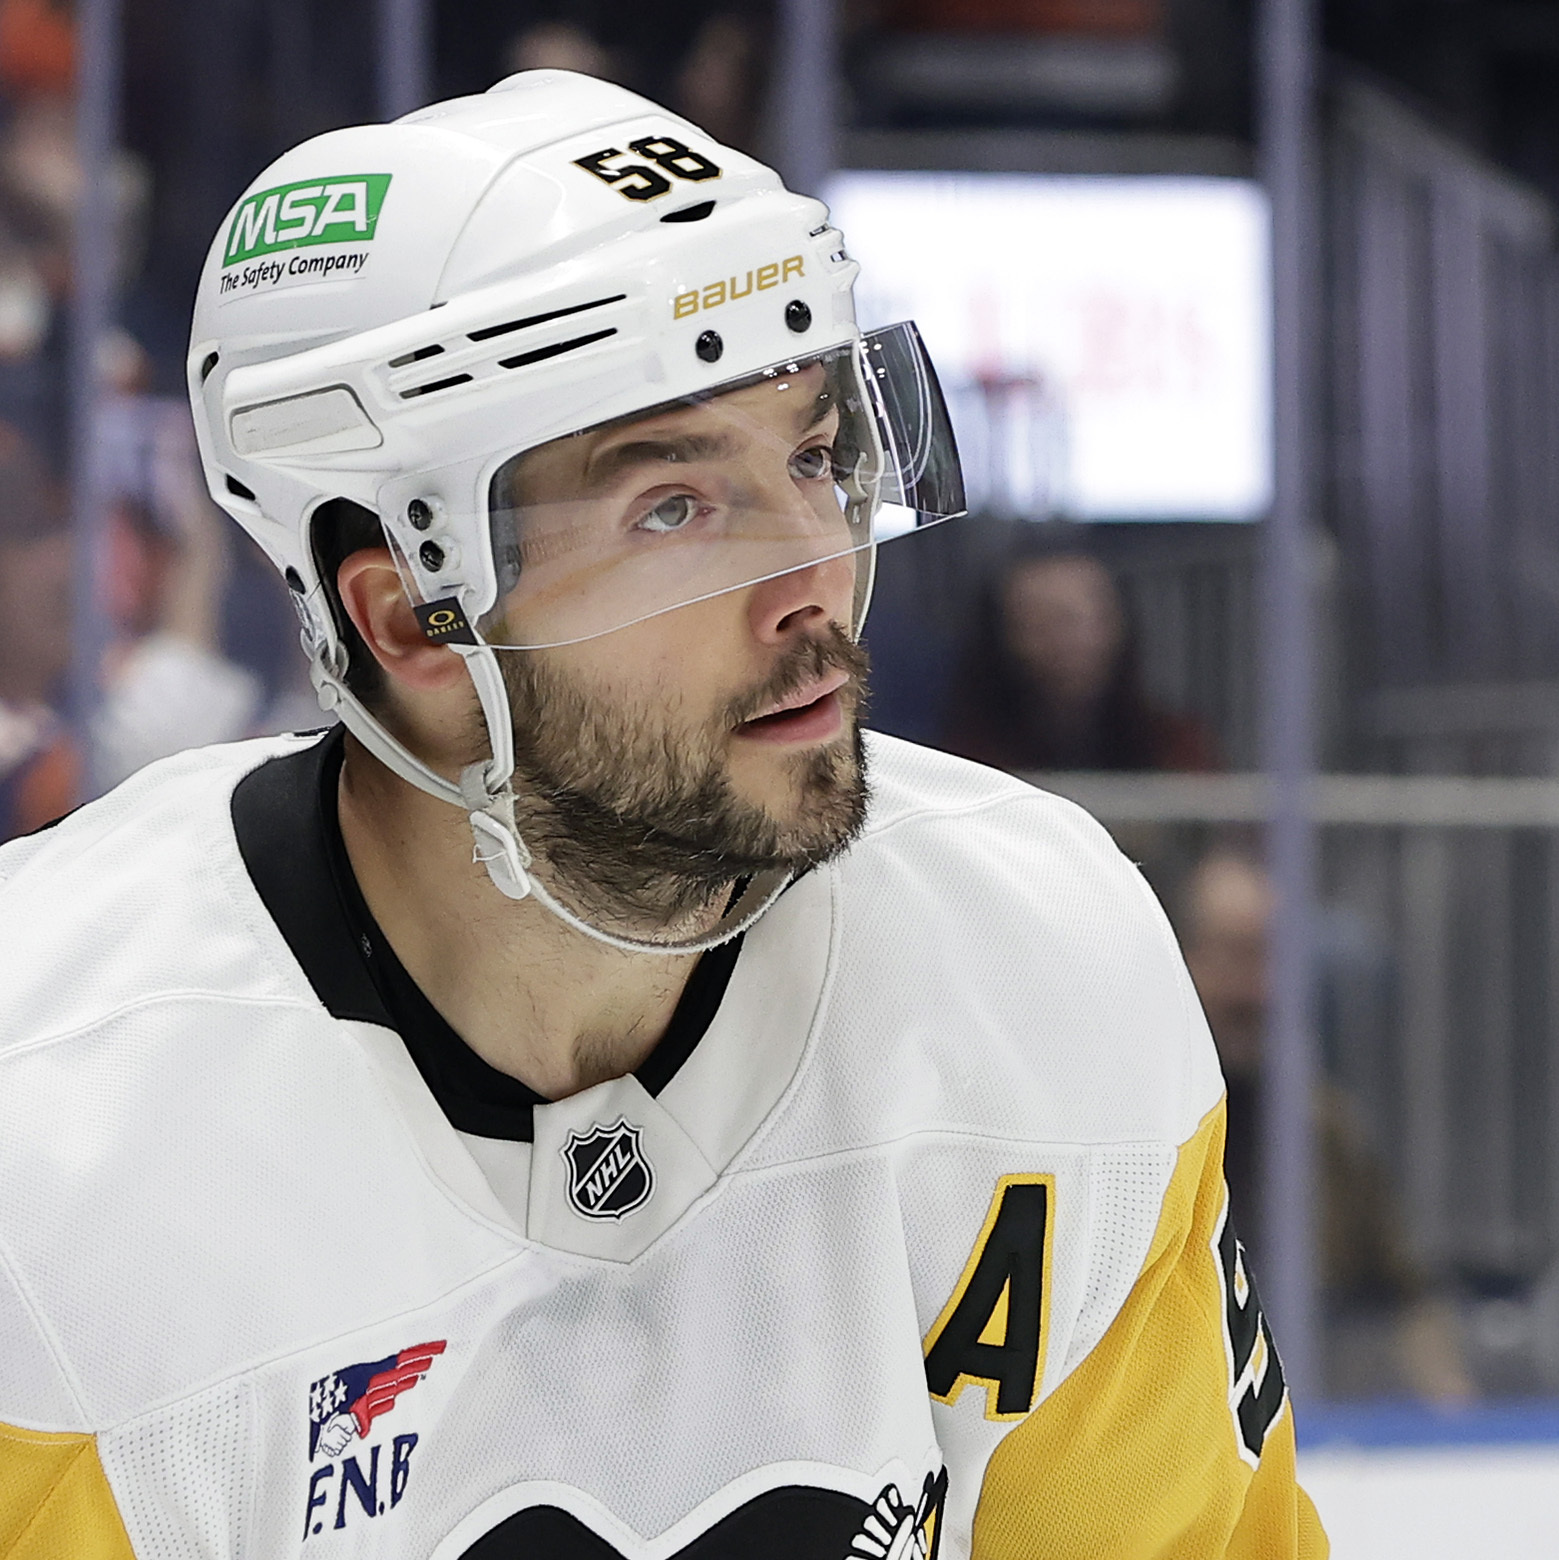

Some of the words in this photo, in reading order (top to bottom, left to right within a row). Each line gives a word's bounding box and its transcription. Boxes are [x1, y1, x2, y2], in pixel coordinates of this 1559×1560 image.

[571, 136, 723, 203] 58
[228, 181, 368, 257] MSA
[220, 273, 239, 294] The
[241, 261, 285, 289] Safety
[288, 252, 369, 277] Company
[585, 1144, 631, 1206] NHL
[922, 1167, 1054, 1420] A
